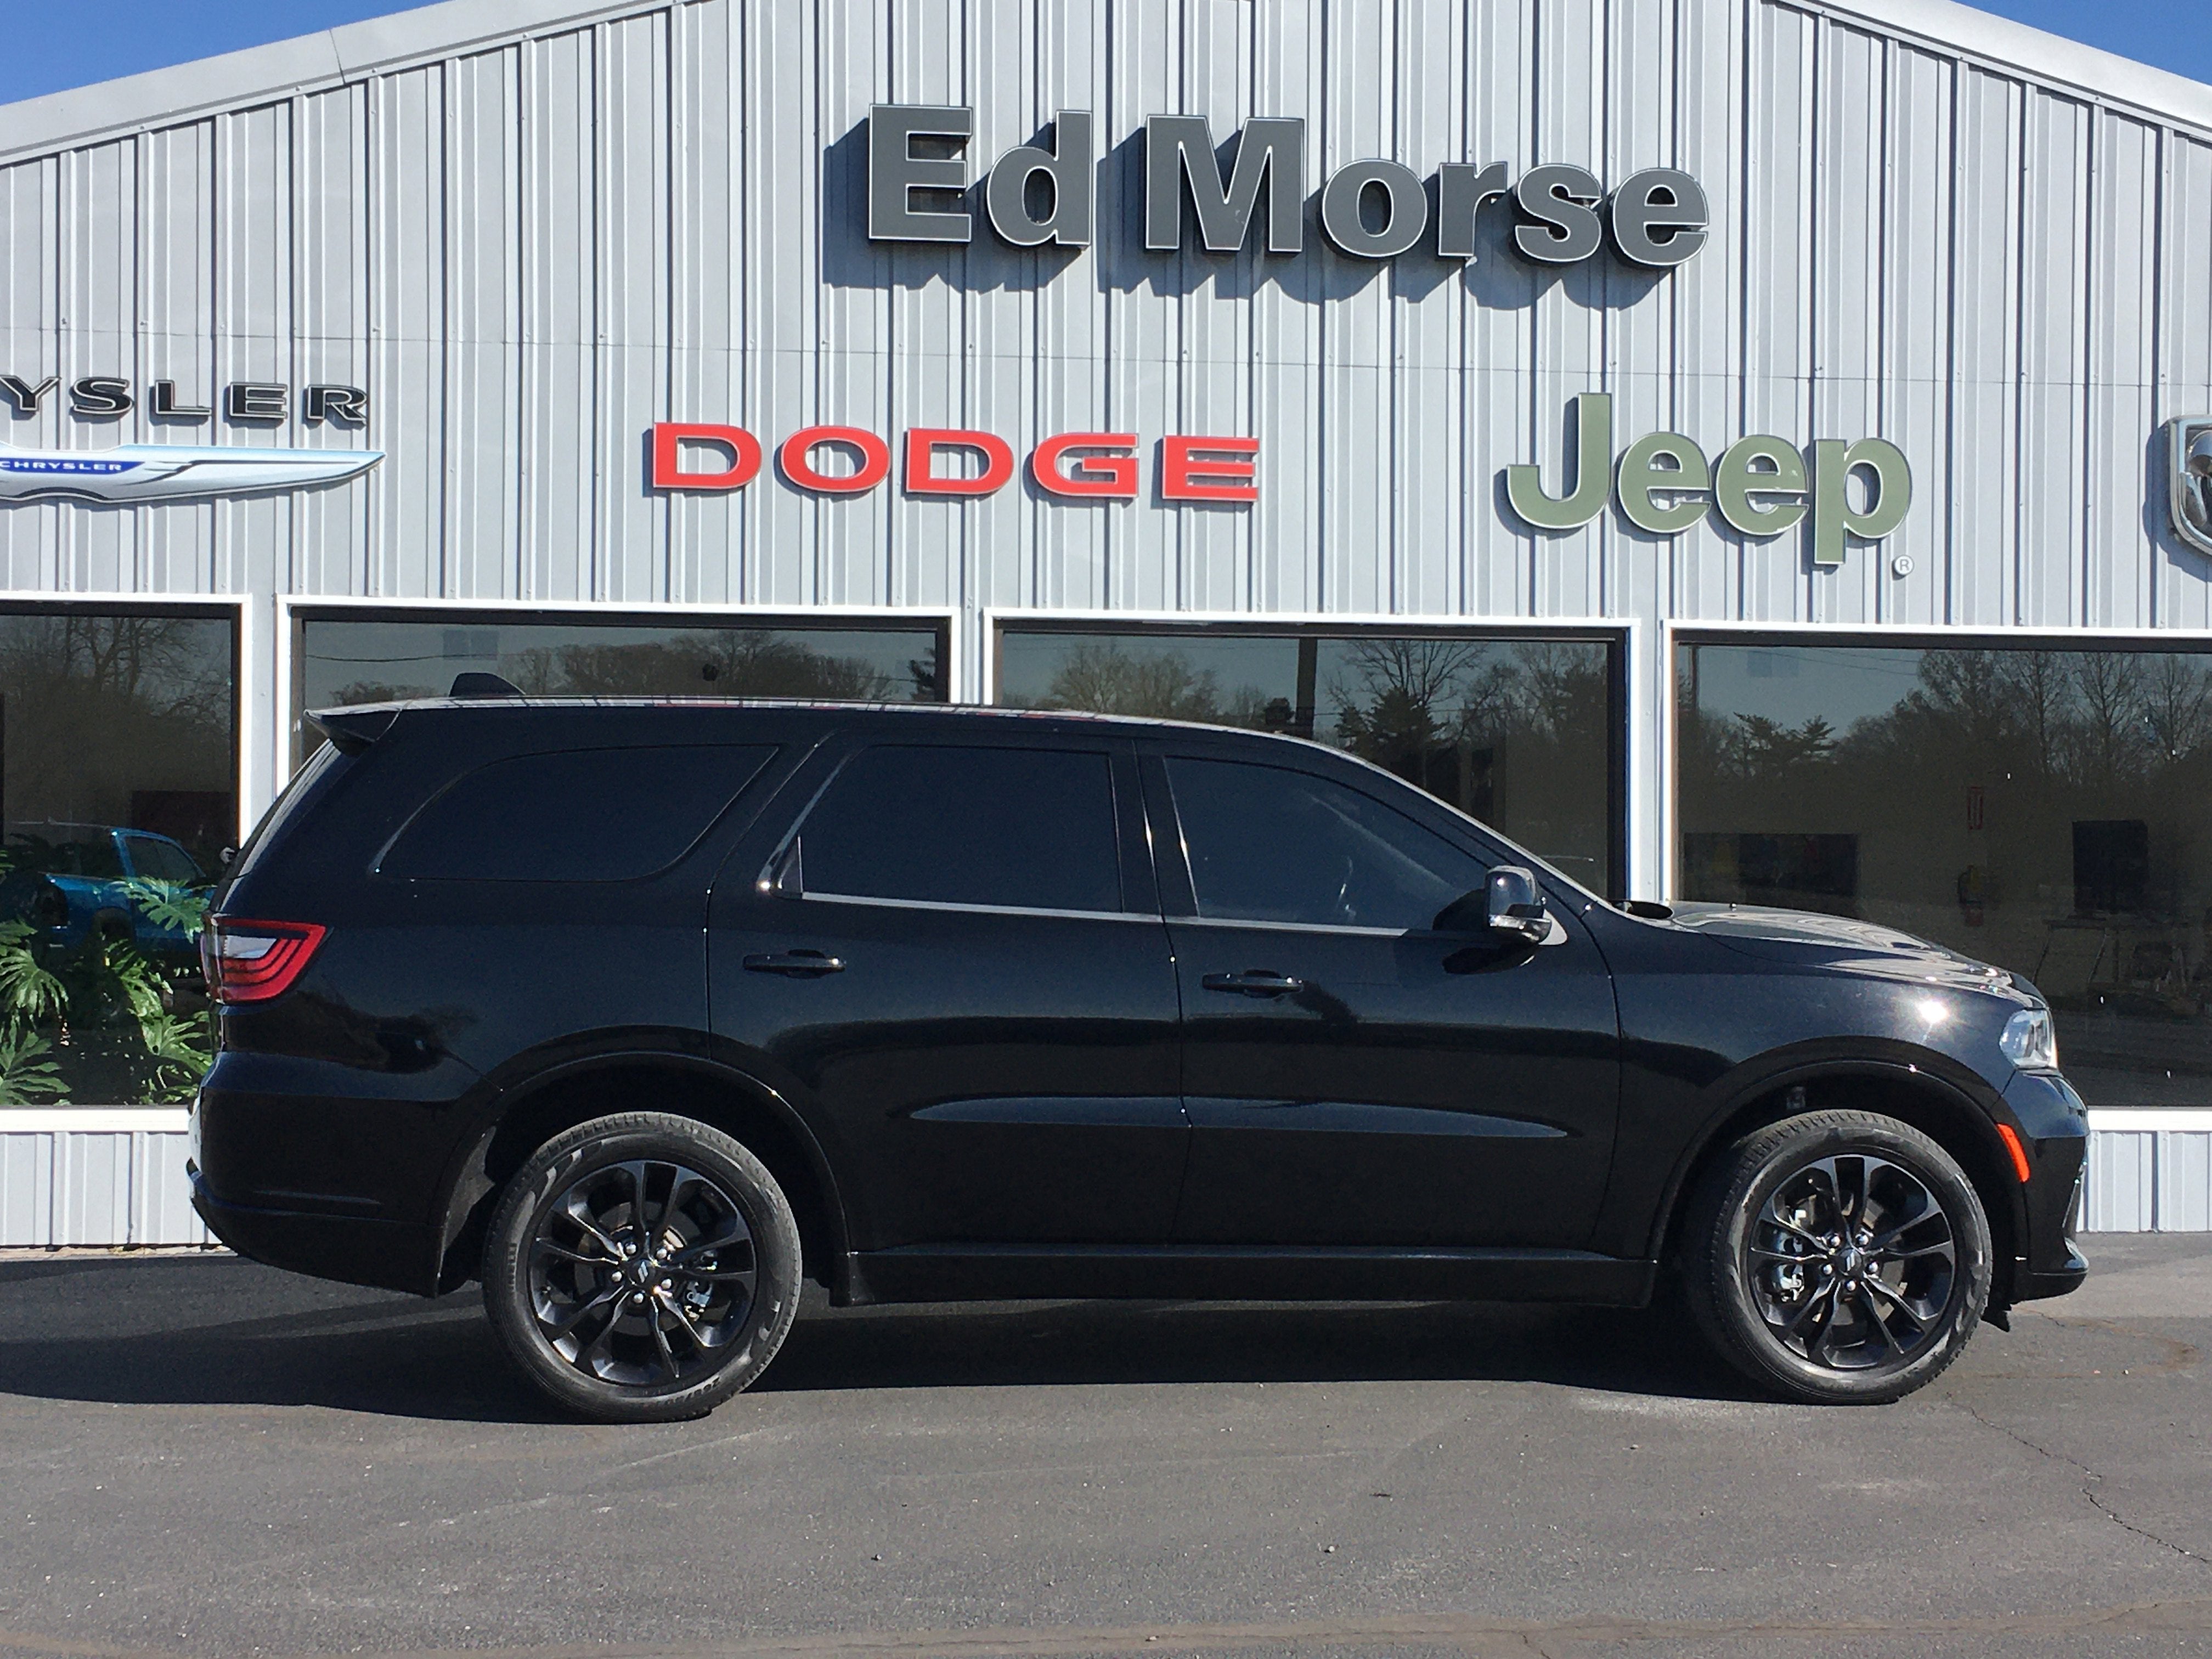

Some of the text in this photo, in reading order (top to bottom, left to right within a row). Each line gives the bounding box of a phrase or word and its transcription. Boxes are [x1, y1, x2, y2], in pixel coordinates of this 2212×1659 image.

[868, 104, 1710, 266] Ed Morse
[0, 375, 367, 424] YSLER
[0, 461, 122, 471] CHRYSLER
[652, 422, 1260, 503] DODGE
[1506, 392, 1912, 565] Jeep
